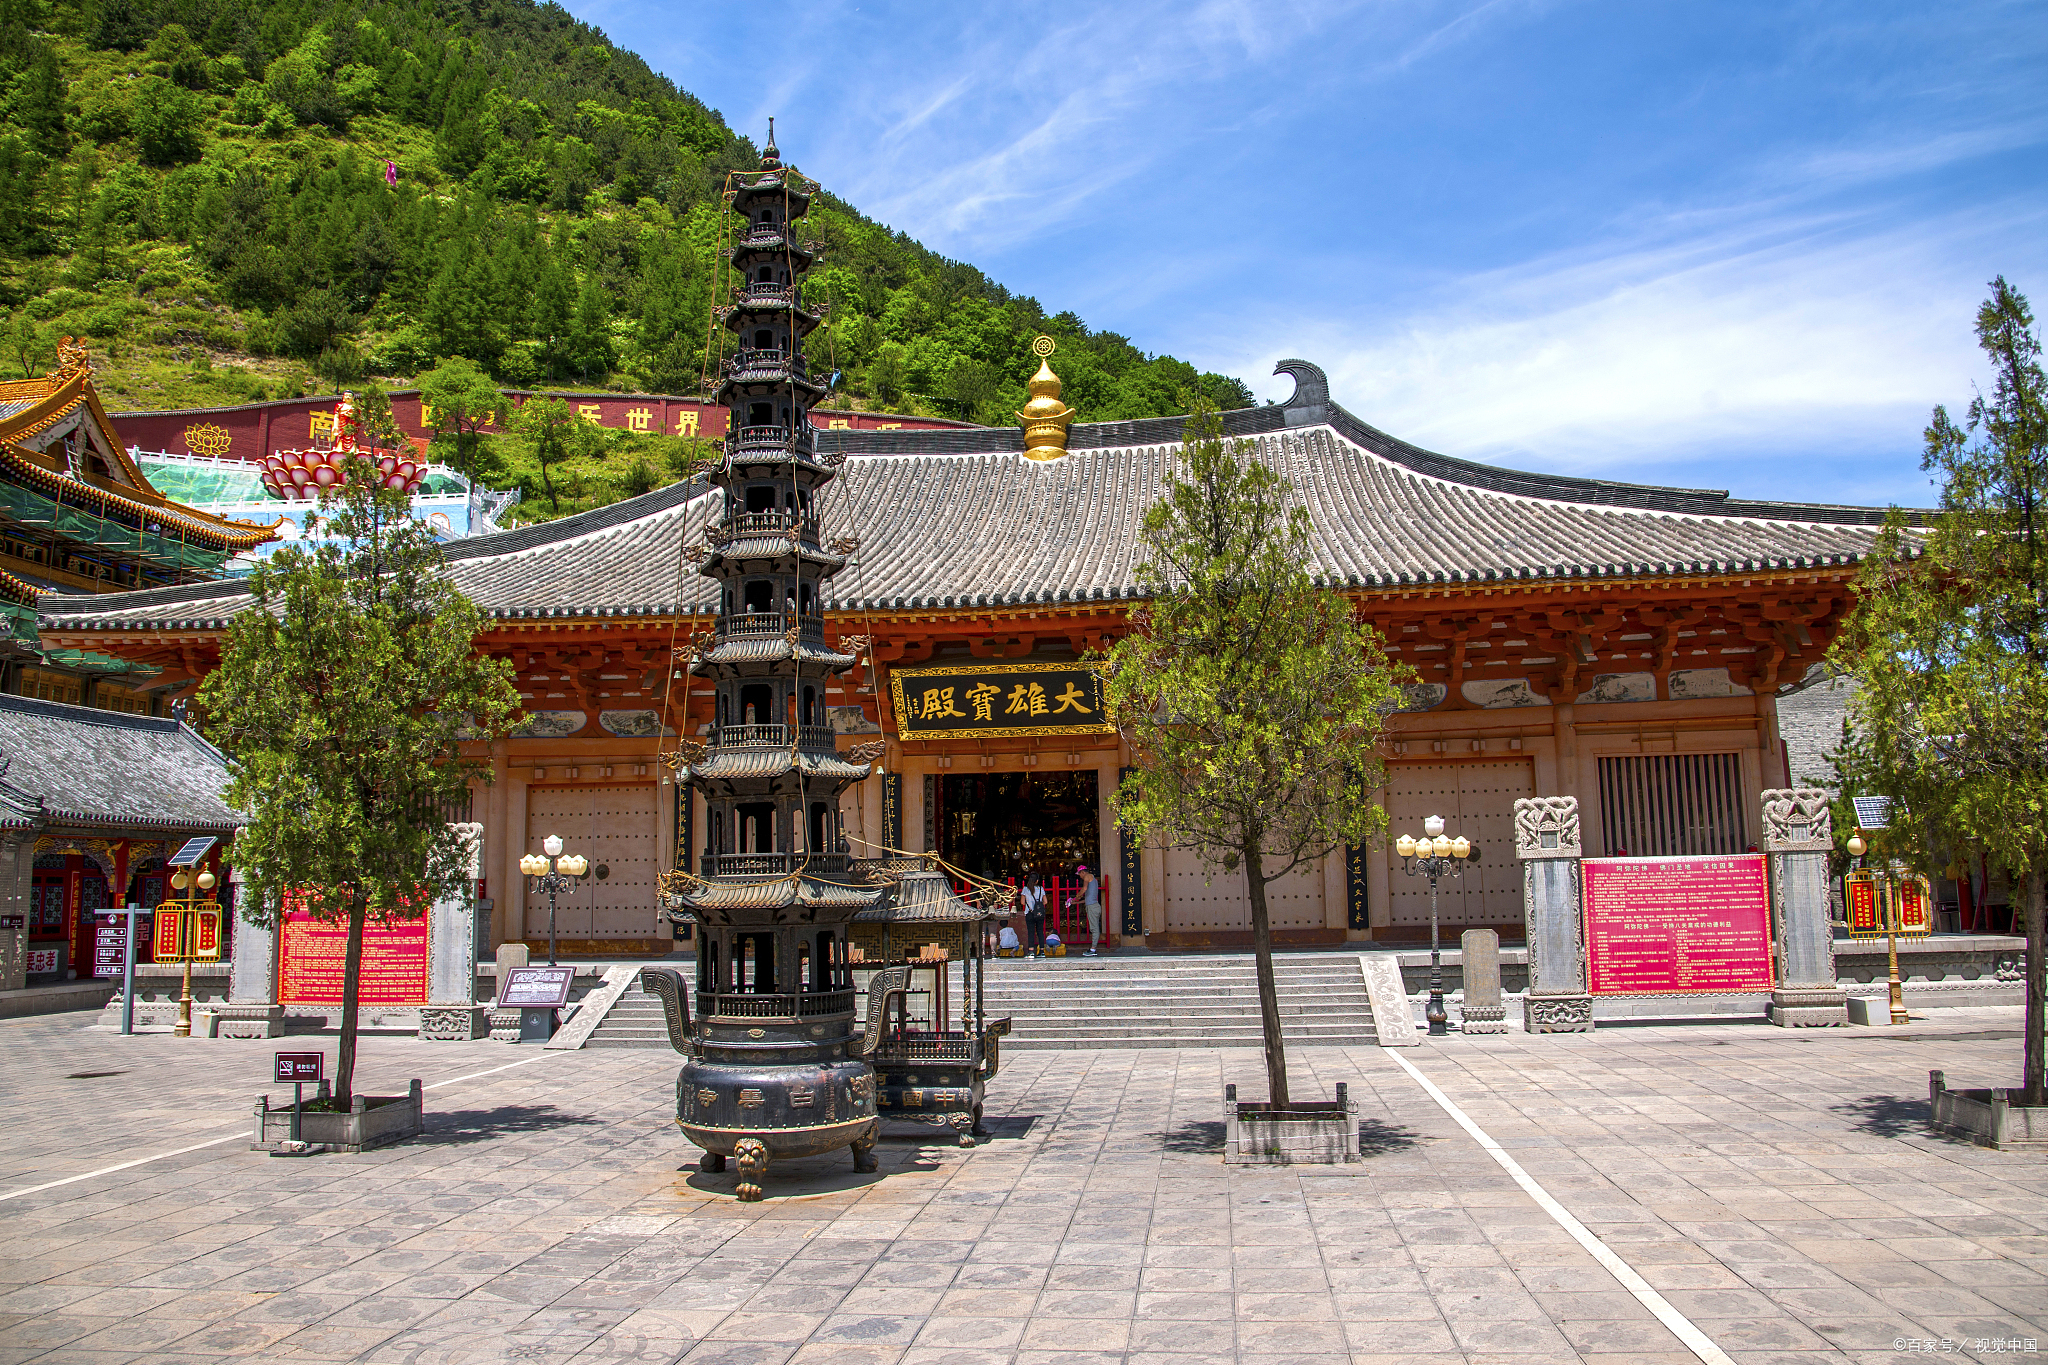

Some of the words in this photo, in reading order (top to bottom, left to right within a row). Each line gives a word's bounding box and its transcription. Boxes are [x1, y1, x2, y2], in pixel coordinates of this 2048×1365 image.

[919, 681, 1093, 722] 大雄寶殿
[697, 1086, 817, 1110] 白雲寺
